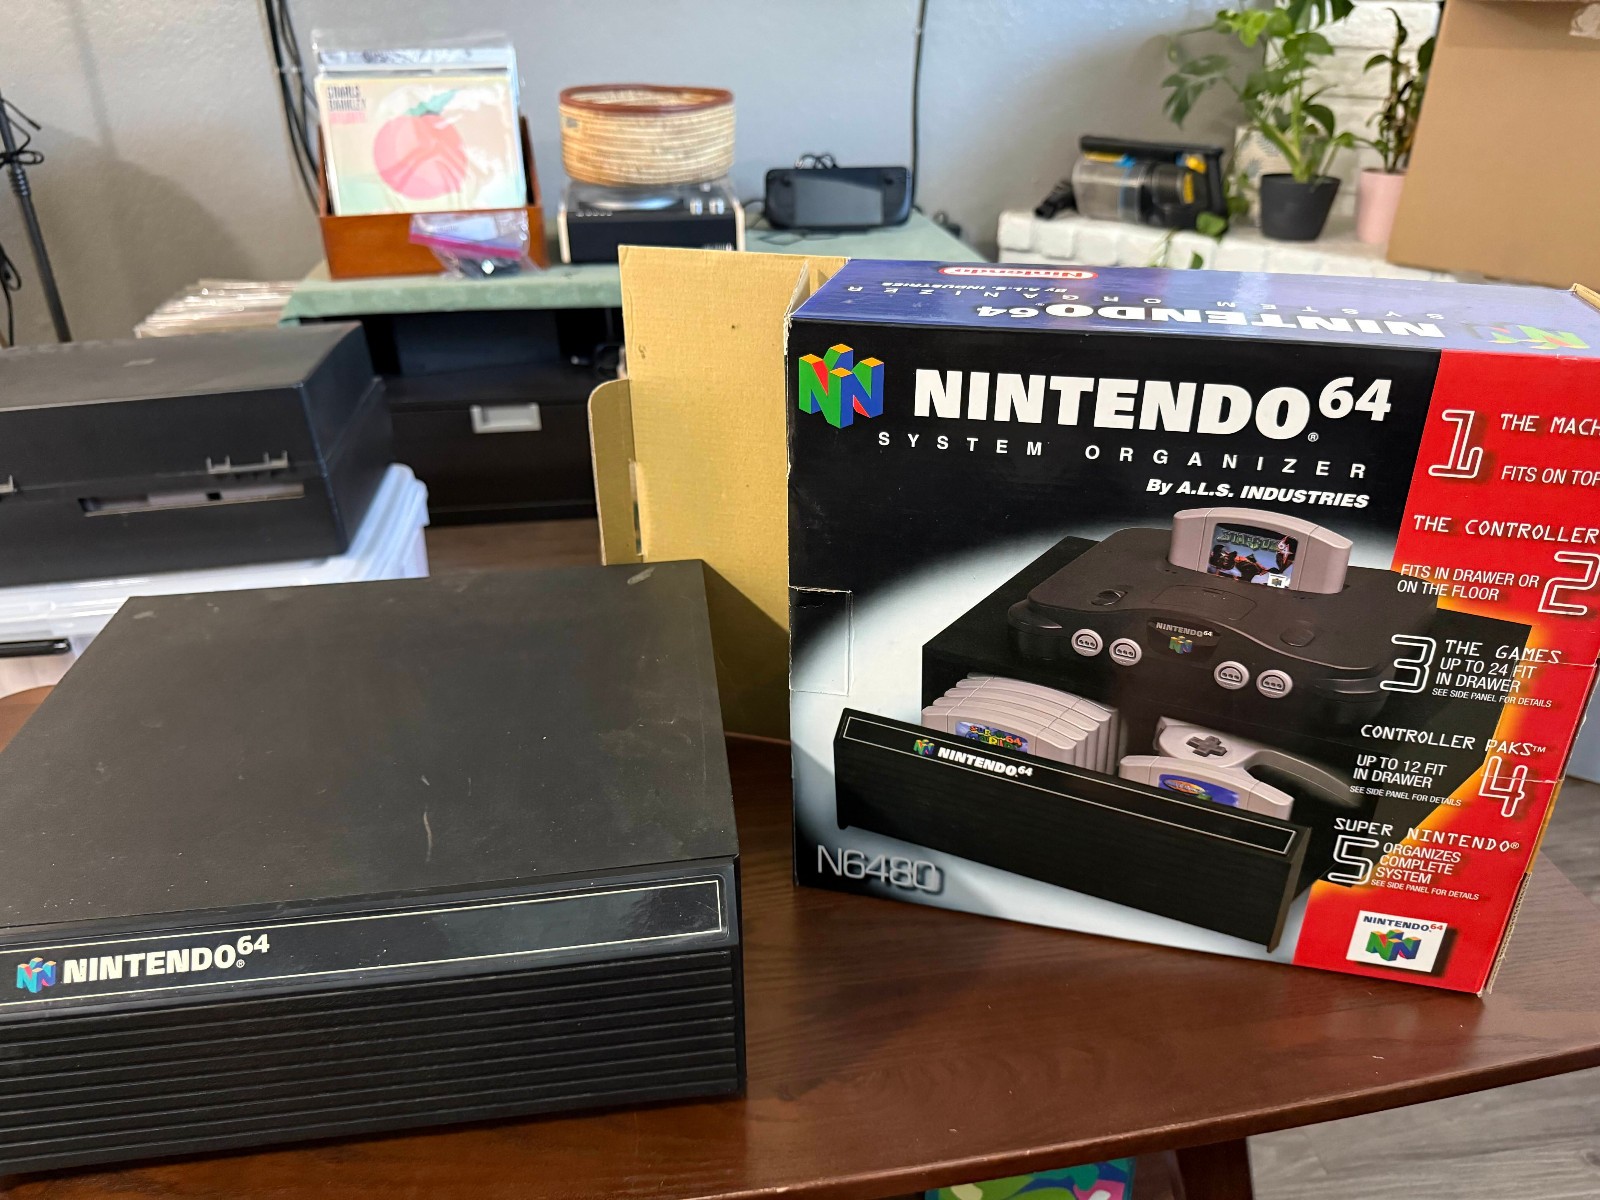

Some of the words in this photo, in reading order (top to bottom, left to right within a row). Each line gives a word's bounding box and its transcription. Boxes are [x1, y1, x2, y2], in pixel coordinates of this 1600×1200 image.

[848, 286, 1161, 304] ORGANIZER
[881, 282, 986, 290] INDUSTRIES
[1217, 301, 1444, 320] SYSTEM
[1500, 413, 1540, 432] THE
[878, 431, 1042, 456] SYSTEM
[1085, 445, 1365, 479] ORGANIZER
[1501, 465, 1538, 482] FITS
[1541, 467, 1567, 484] ON
[1146, 479, 1173, 496] By
[1176, 480, 1234, 498] A.L.S.
[1240, 485, 1370, 509] INDUSTRIES
[1413, 514, 1451, 533] THE
[1465, 519, 1599, 544] CONTROLLER
[1400, 564, 1431, 579] FITS
[1434, 566, 1450, 580] IN
[1453, 568, 1515, 586] DRAWER
[1518, 574, 1540, 588] OR
[1537, 550, 1600, 616] 2
[1397, 579, 1418, 594] ON
[1421, 581, 1449, 597] THE
[1451, 585, 1500, 601] FLOOR
[1445, 639, 1484, 657] THE
[1495, 645, 1562, 664] GAMES
[1379, 633, 1437, 694] 3
[1439, 656, 1461, 671] UP
[1464, 659, 1484, 674] TO
[1487, 662, 1508, 677] 24
[1512, 665, 1538, 679] FIT
[1435, 672, 1453, 687] IN
[1455, 674, 1521, 693] DRAWER
[1431, 687, 1449, 697] SEE
[1449, 689, 1469, 700] SIDE
[1470, 691, 1497, 703] PANEL
[1498, 695, 1516, 705] FOR
[1517, 697, 1552, 708] DETAILS
[1360, 724, 1476, 750] CONTROLLER
[1356, 754, 1377, 767] UP
[1379, 756, 1399, 771] TO
[1402, 760, 1419, 773] 12
[1423, 762, 1447, 776] FIT
[1352, 768, 1368, 781] IN
[1371, 770, 1433, 789] DRAWER
[1478, 755, 1528, 818] 4
[1349, 785, 1366, 795] SEE
[1366, 787, 1384, 797] SIDE
[1385, 789, 1411, 800] PANEL
[1412, 793, 1429, 802] FOR
[1429, 794, 1462, 806] DETAILS
[1333, 817, 1394, 837] SUPER
[1327, 834, 1380, 886] 5
[1383, 842, 1462, 864] ORGANIZES
[816, 844, 938, 892] N6480
[1379, 854, 1455, 875] COMPLETE
[1375, 867, 1432, 885] SYSTEM
[1370, 879, 1385, 888] SEE
[1386, 881, 1404, 890] SIDE
[1405, 884, 1430, 894] PANEL
[1431, 887, 1447, 896] FOR
[1448, 889, 1480, 901] DETAILS
